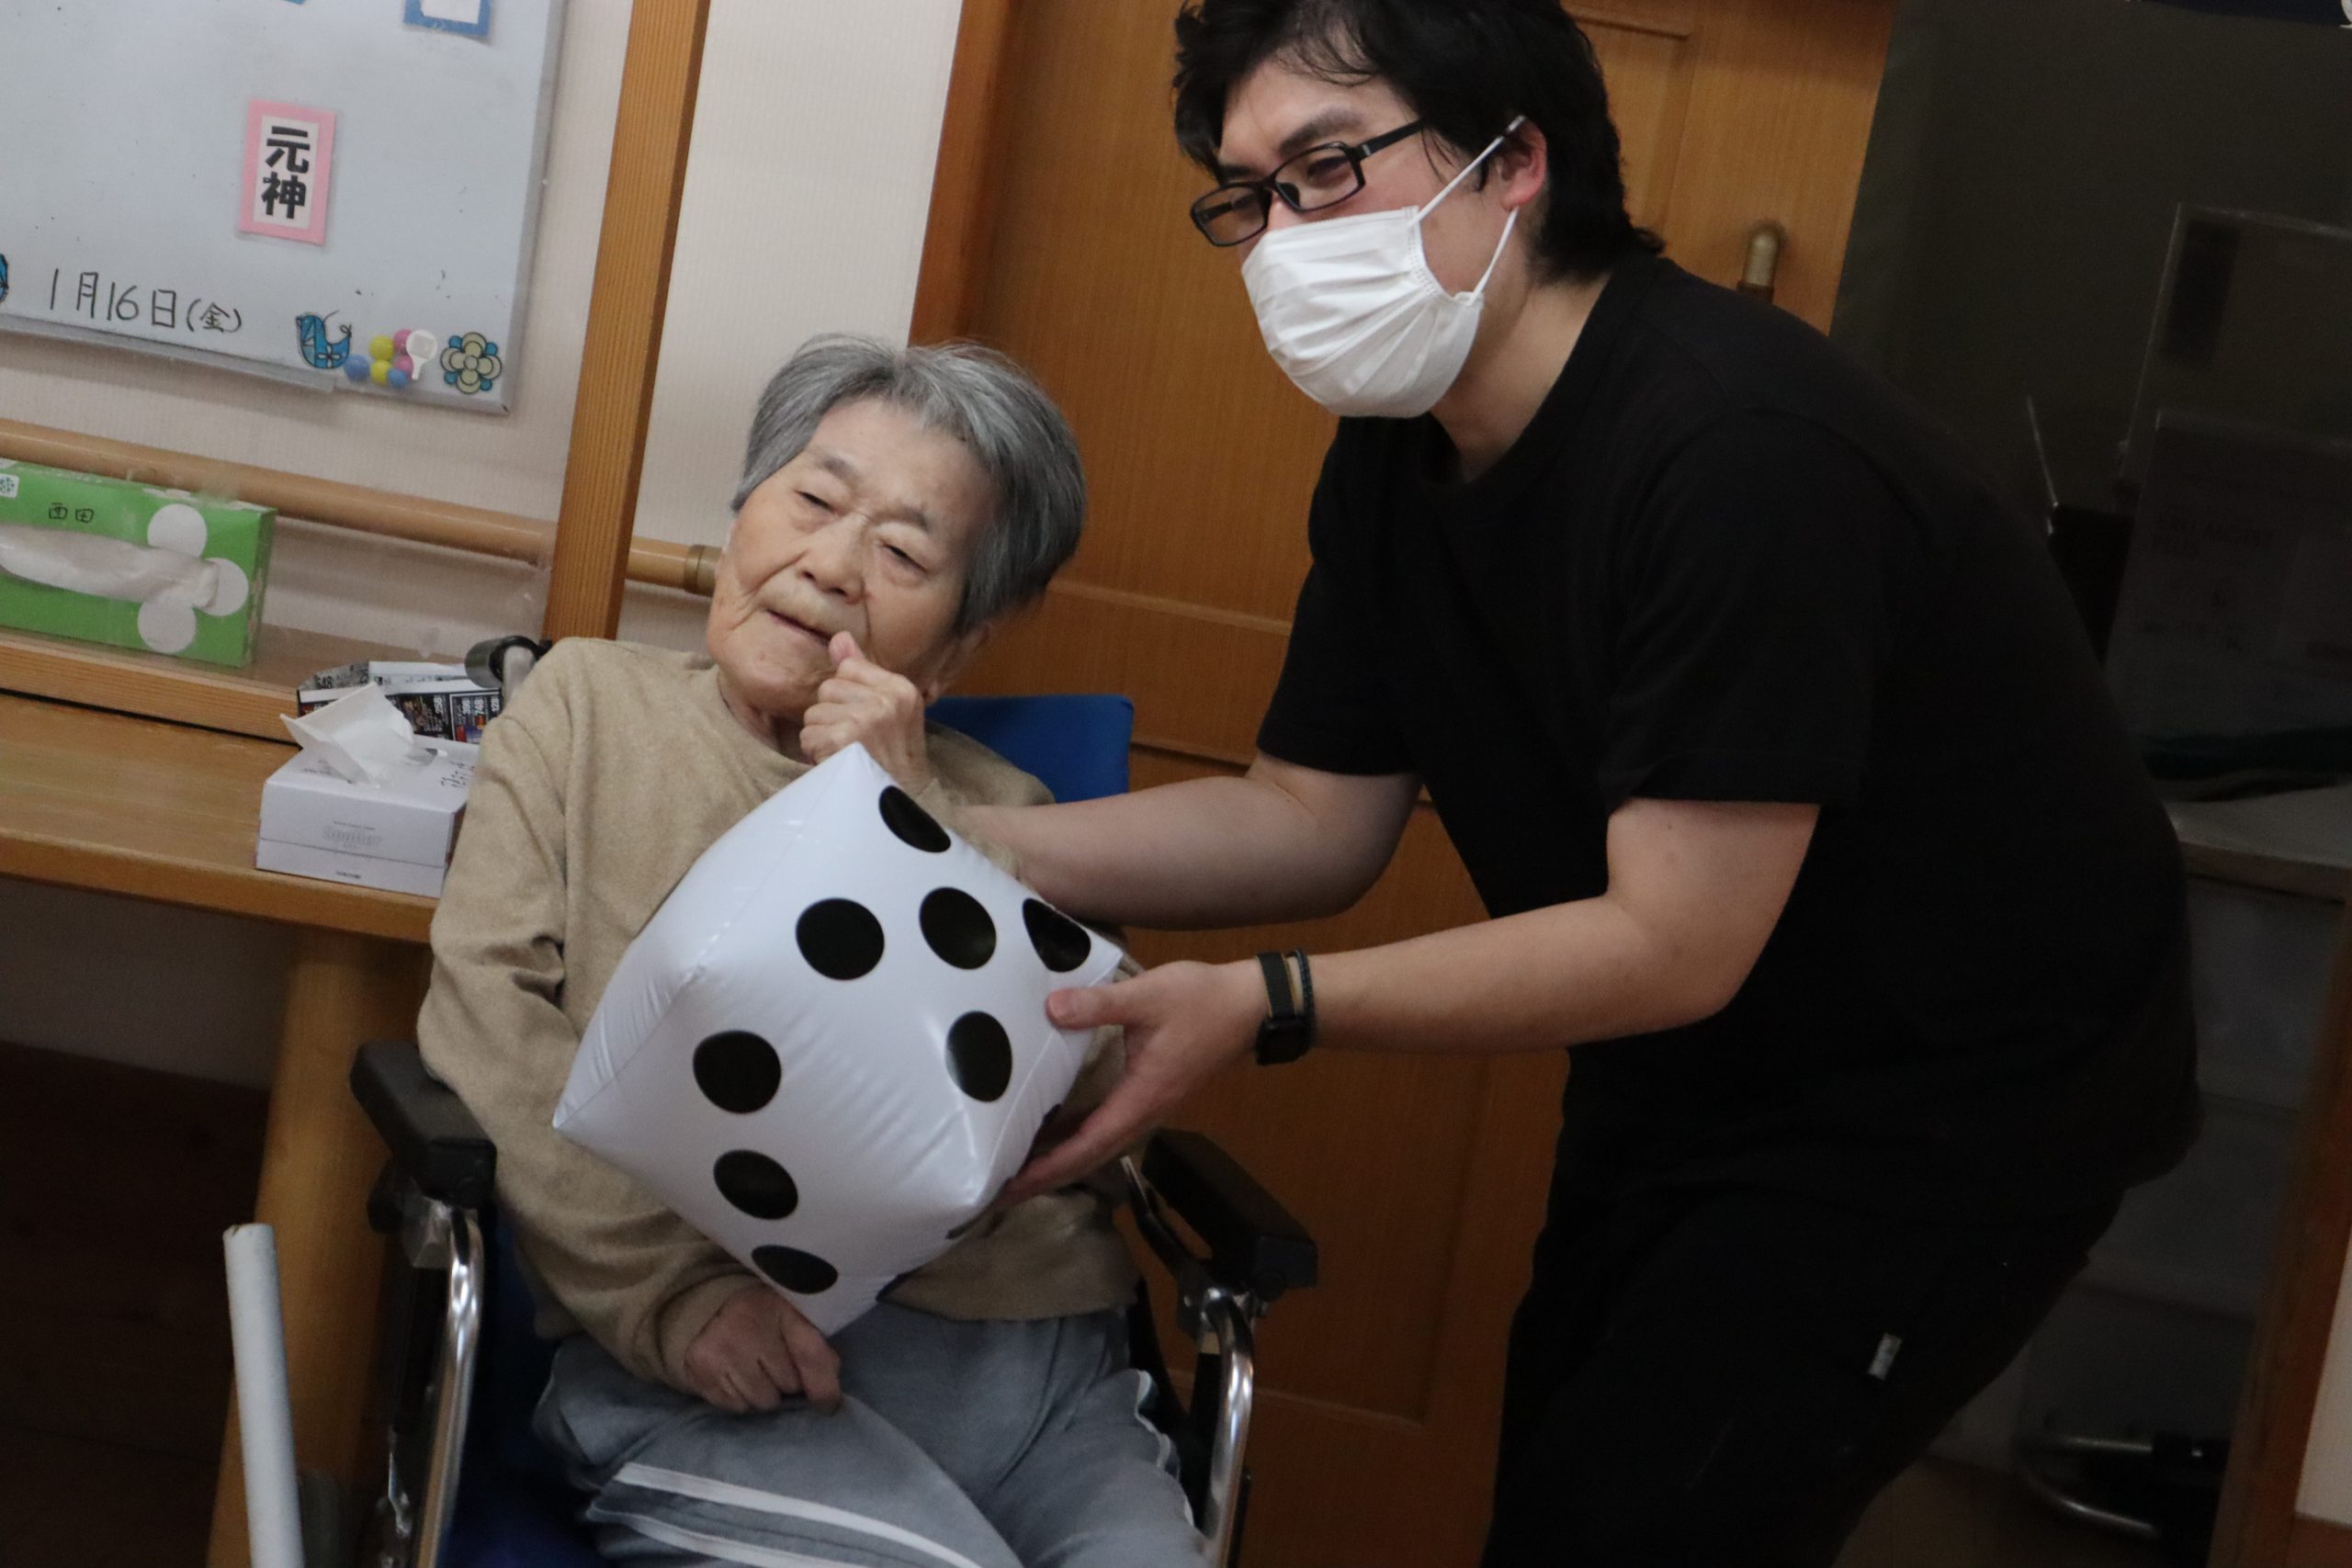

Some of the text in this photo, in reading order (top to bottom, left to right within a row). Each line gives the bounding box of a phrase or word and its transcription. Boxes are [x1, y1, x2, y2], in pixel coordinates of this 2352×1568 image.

[261, 126, 311, 220] 元神
[50, 268, 242, 333] 1月16日(金)
